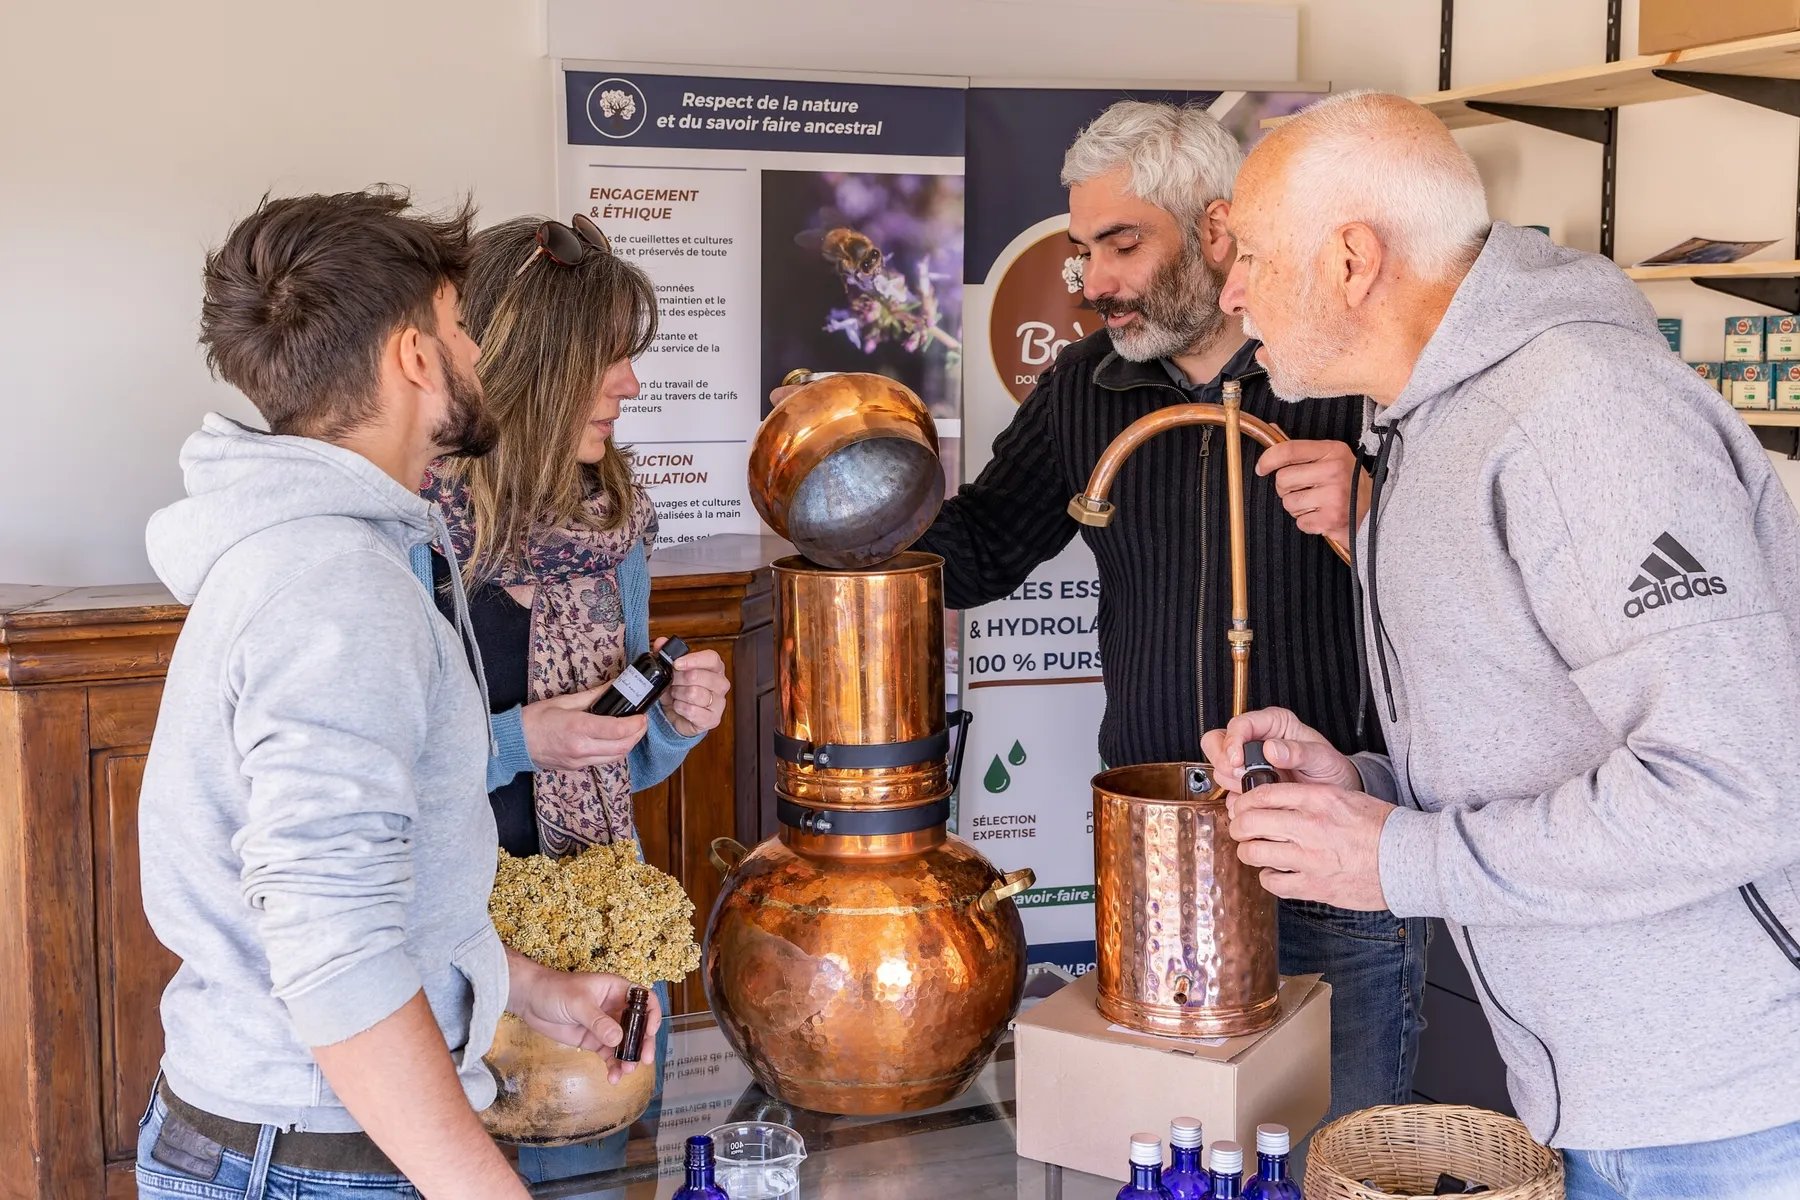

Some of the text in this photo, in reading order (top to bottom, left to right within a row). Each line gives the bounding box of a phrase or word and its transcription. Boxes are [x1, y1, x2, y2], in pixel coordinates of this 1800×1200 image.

[682, 92, 858, 113] Respect de la nature
[656, 114, 883, 136] et du savoir faire ancestral
[590, 188, 700, 202] ENGAGEMENT
[590, 204, 672, 221] & ÉTHIQUE
[614, 234, 627, 243] de
[629, 234, 680, 244] cueillettes
[682, 236, 692, 244] et
[694, 236, 733, 245] cultures
[626, 248, 636, 256] et
[638, 246, 684, 257] préservés
[686, 248, 699, 256] de
[701, 248, 727, 257] toute
[655, 284, 694, 292] sonnées
[660, 296, 726, 304] maintien et le
[669, 308, 685, 316] des
[688, 308, 726, 318] espèces
[662, 344, 694, 352] service
[697, 344, 709, 352] de
[712, 344, 720, 352] la
[650, 380, 662, 388] du
[665, 380, 693, 388] travail
[696, 380, 708, 388] de
[698, 392, 711, 400] de
[714, 391, 738, 400] tarifs
[620, 404, 662, 412] érateurs
[654, 501, 688, 509] uvages
[702, 498, 741, 507] cultures
[657, 511, 694, 519] éalisées
[697, 510, 702, 518] à
[1624, 574, 1727, 618] adidas
[970, 620, 981, 638] &
[969, 654, 1006, 675] 100
[1012, 654, 1036, 671] %
[972, 814, 1036, 827] SÉLECTION
[973, 828, 1036, 840] EXPERTISE
